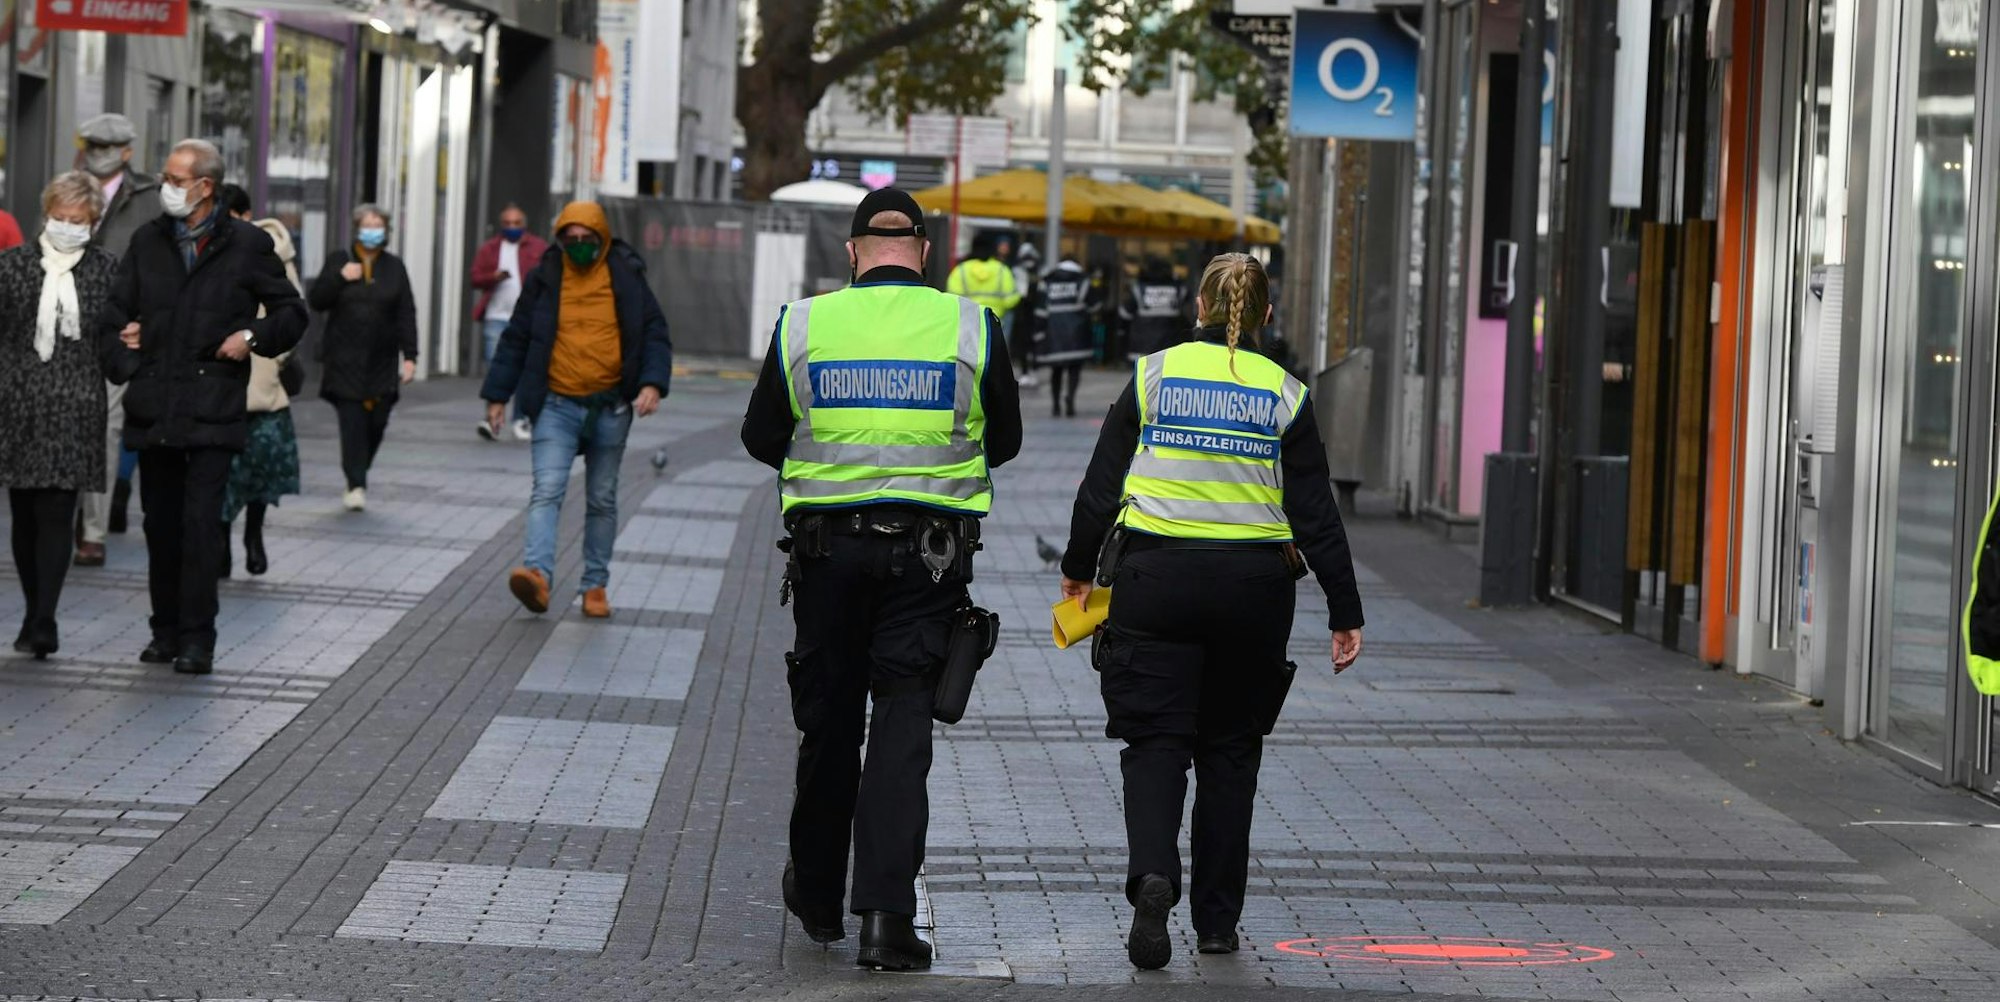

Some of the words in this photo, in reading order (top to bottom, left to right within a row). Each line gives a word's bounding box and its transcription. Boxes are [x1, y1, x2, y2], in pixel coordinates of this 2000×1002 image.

[81, 0, 170, 22] EINGANG
[1318, 37, 1394, 116] O2
[820, 368, 943, 401] ORDNUNGSAMT
[1151, 430, 1273, 455] EINSATZLEITUNG
